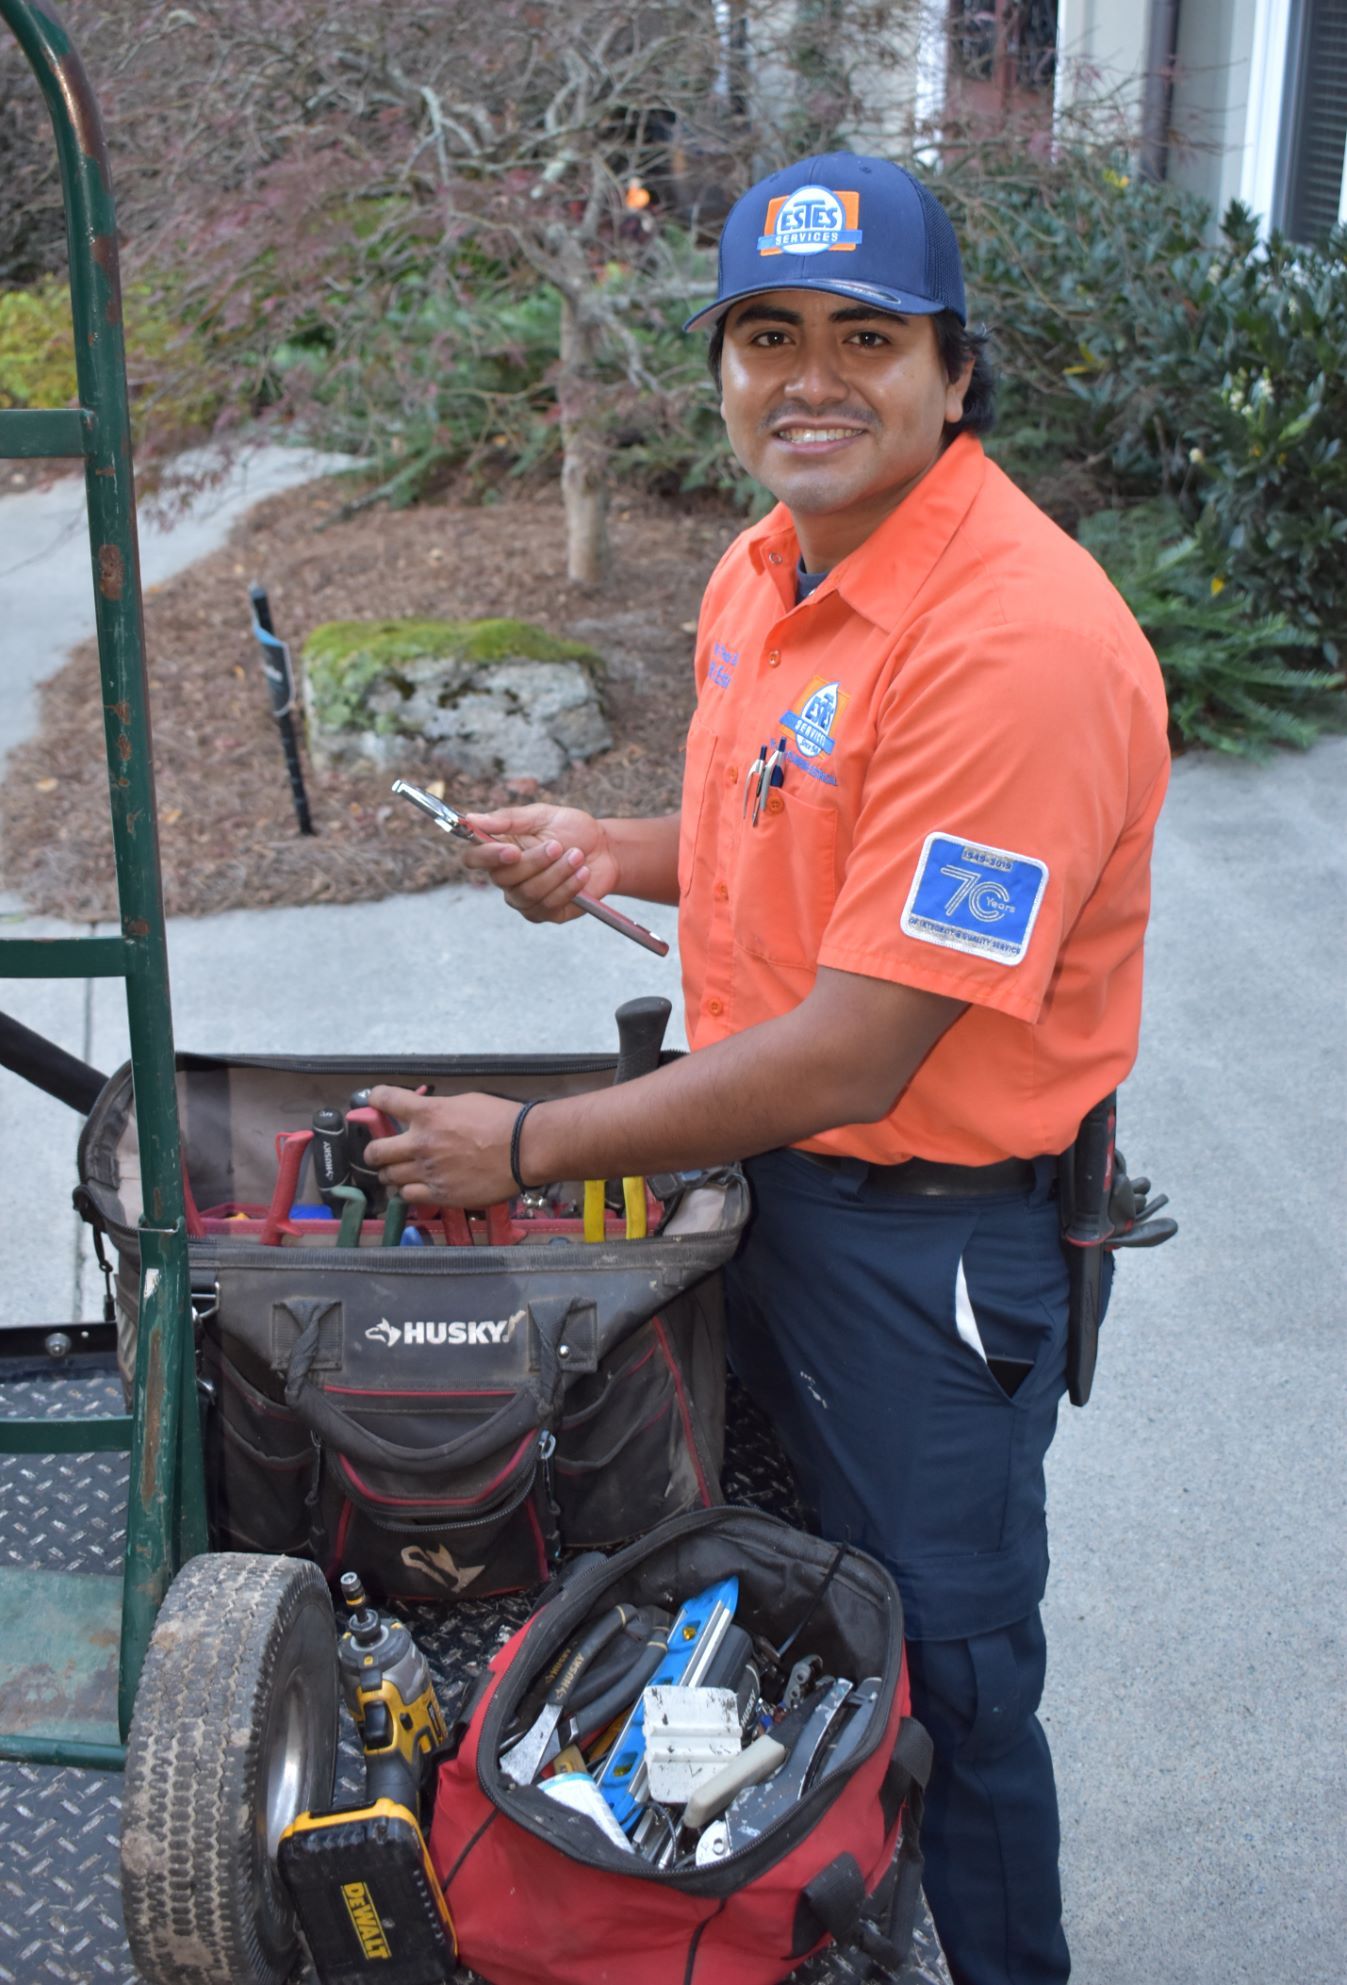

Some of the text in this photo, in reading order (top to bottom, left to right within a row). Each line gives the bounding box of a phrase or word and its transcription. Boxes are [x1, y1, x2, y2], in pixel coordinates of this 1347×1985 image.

[780, 200, 838, 231] ESTES
[775, 232, 839, 245] SERVICES
[985, 896, 1015, 913] Years
[323, 1141, 334, 1172] HUSKY
[404, 1321, 508, 1344] HUSKY
[561, 1651, 584, 1689] HUSKY
